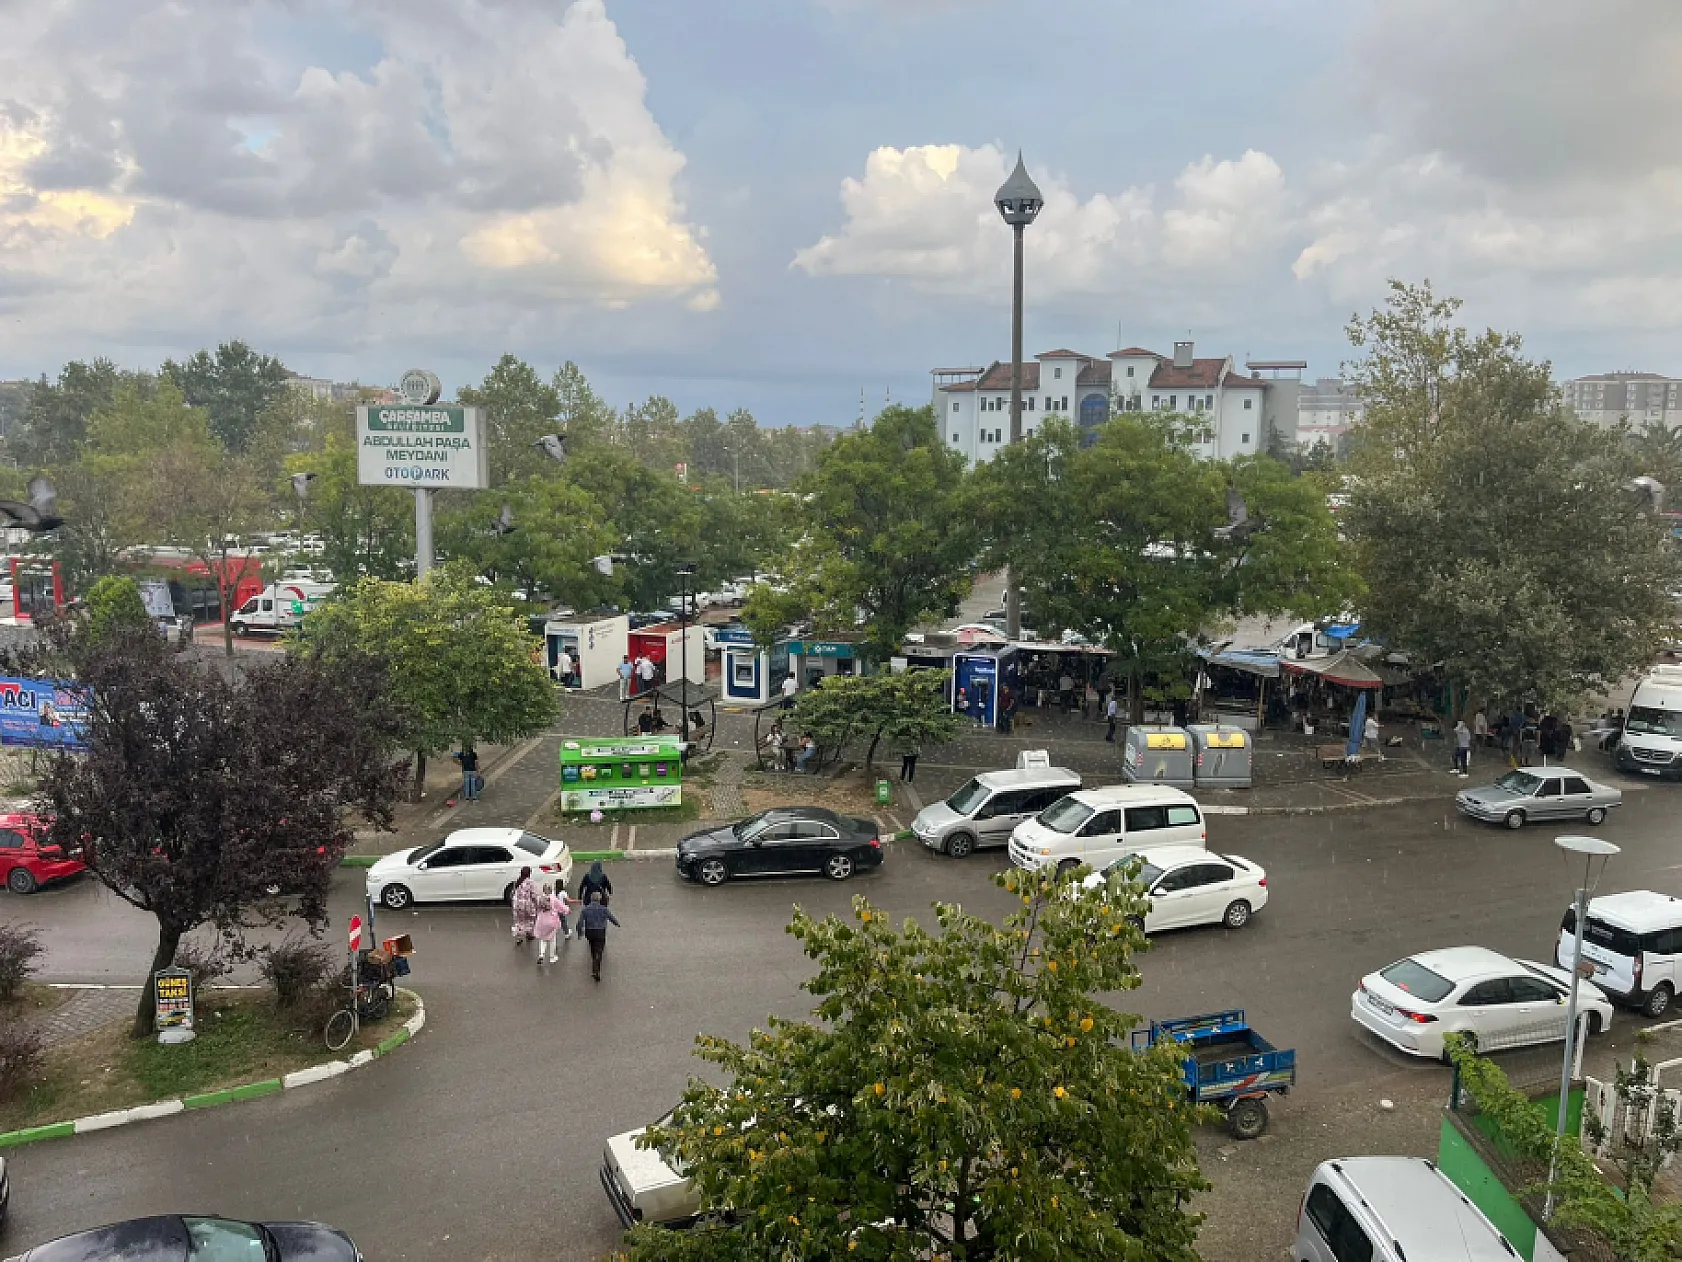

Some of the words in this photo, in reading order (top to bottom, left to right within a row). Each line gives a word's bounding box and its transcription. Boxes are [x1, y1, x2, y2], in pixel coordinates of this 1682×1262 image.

[363, 436, 433, 447] ABDULLAH
[435, 437, 471, 451] PAŞA
[386, 450, 448, 462] MEYDANI
[384, 466, 450, 480] OTOPARK
